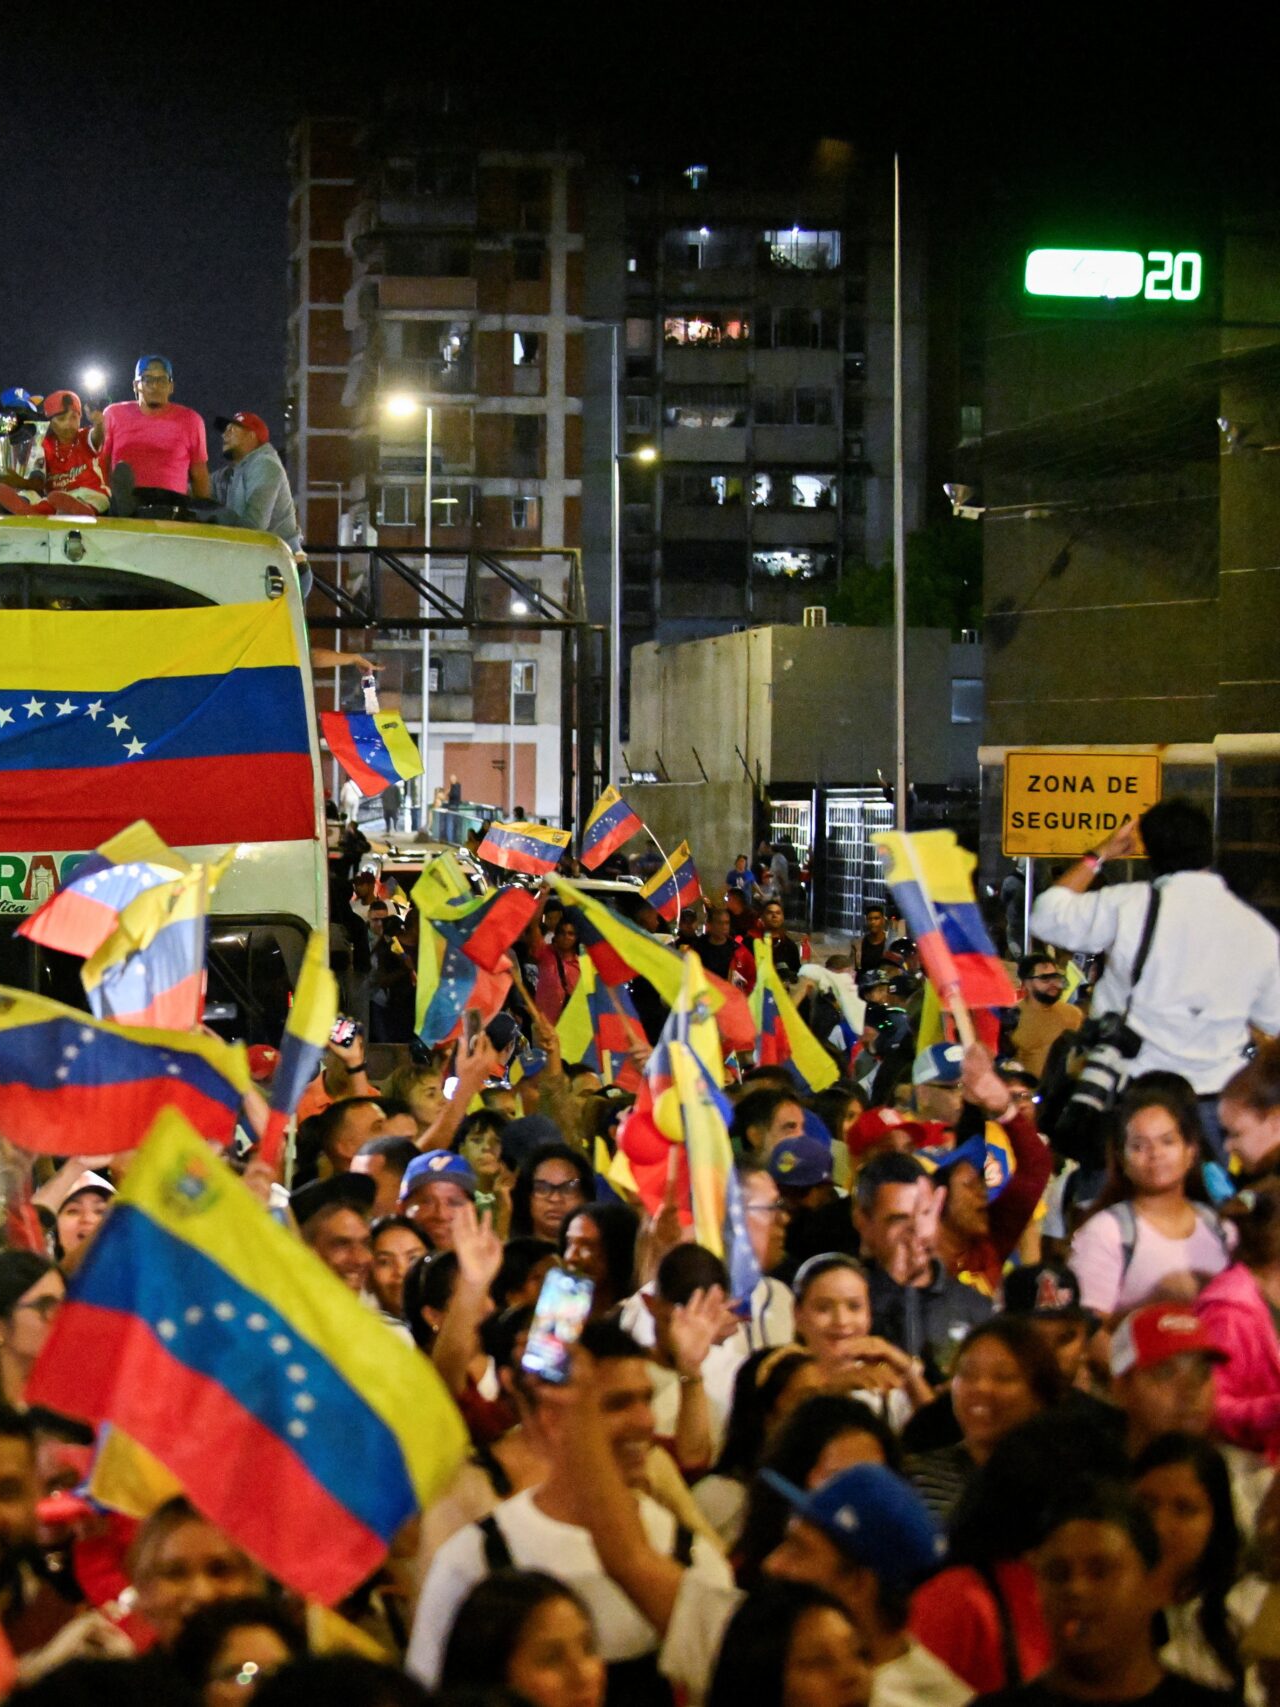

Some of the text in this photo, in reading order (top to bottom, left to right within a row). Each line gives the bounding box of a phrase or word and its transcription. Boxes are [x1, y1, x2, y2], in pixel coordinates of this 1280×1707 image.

[1144, 251, 1202, 301] 20
[1027, 775, 1138, 794] ZONA DE
[1011, 811, 1144, 831] SEGURIDA
